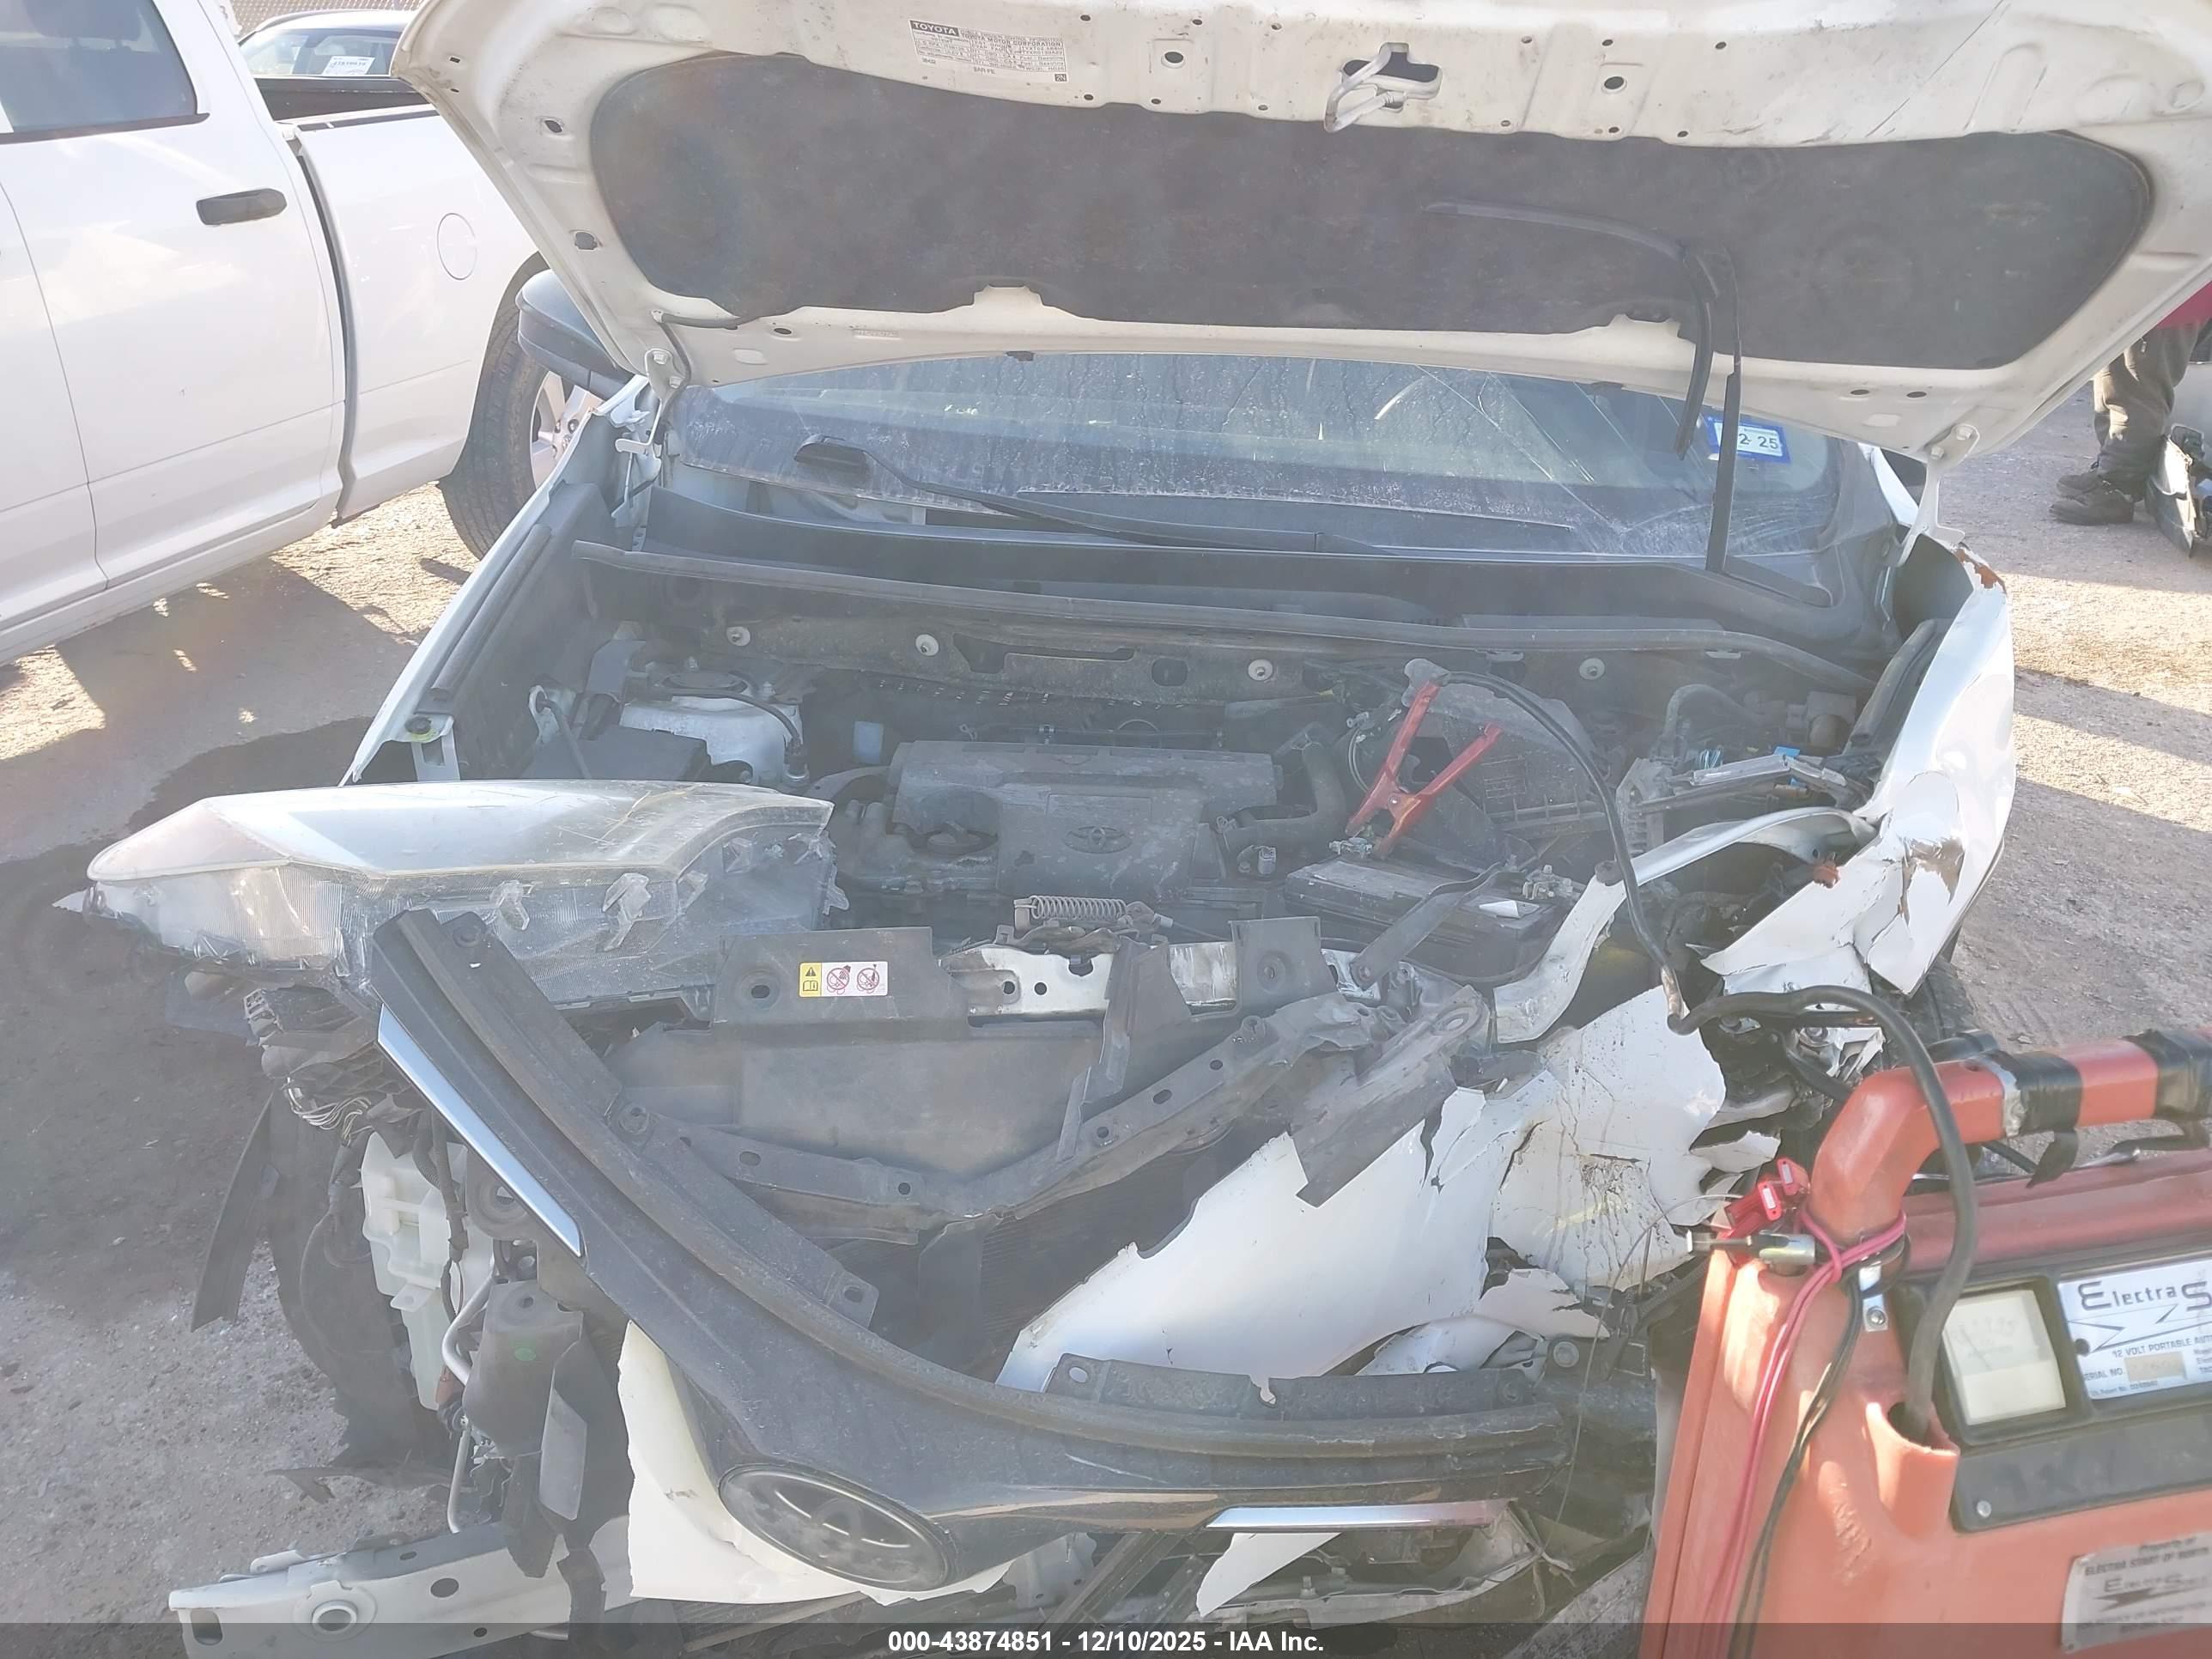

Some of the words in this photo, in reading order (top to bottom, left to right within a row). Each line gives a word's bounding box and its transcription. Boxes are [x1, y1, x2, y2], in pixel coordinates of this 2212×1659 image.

[913, 21, 957, 35] TOYOTA
[987, 36, 1012, 45] MOTOR
[1738, 433, 1750, 446] 2
[1757, 435, 1779, 449] 25
[2112, 1349, 2124, 1358] 12
[2125, 1345, 2146, 1357] VOLT
[2148, 1338, 2192, 1352] PORTABLE
[2084, 1370, 2107, 1381] ERIAL
